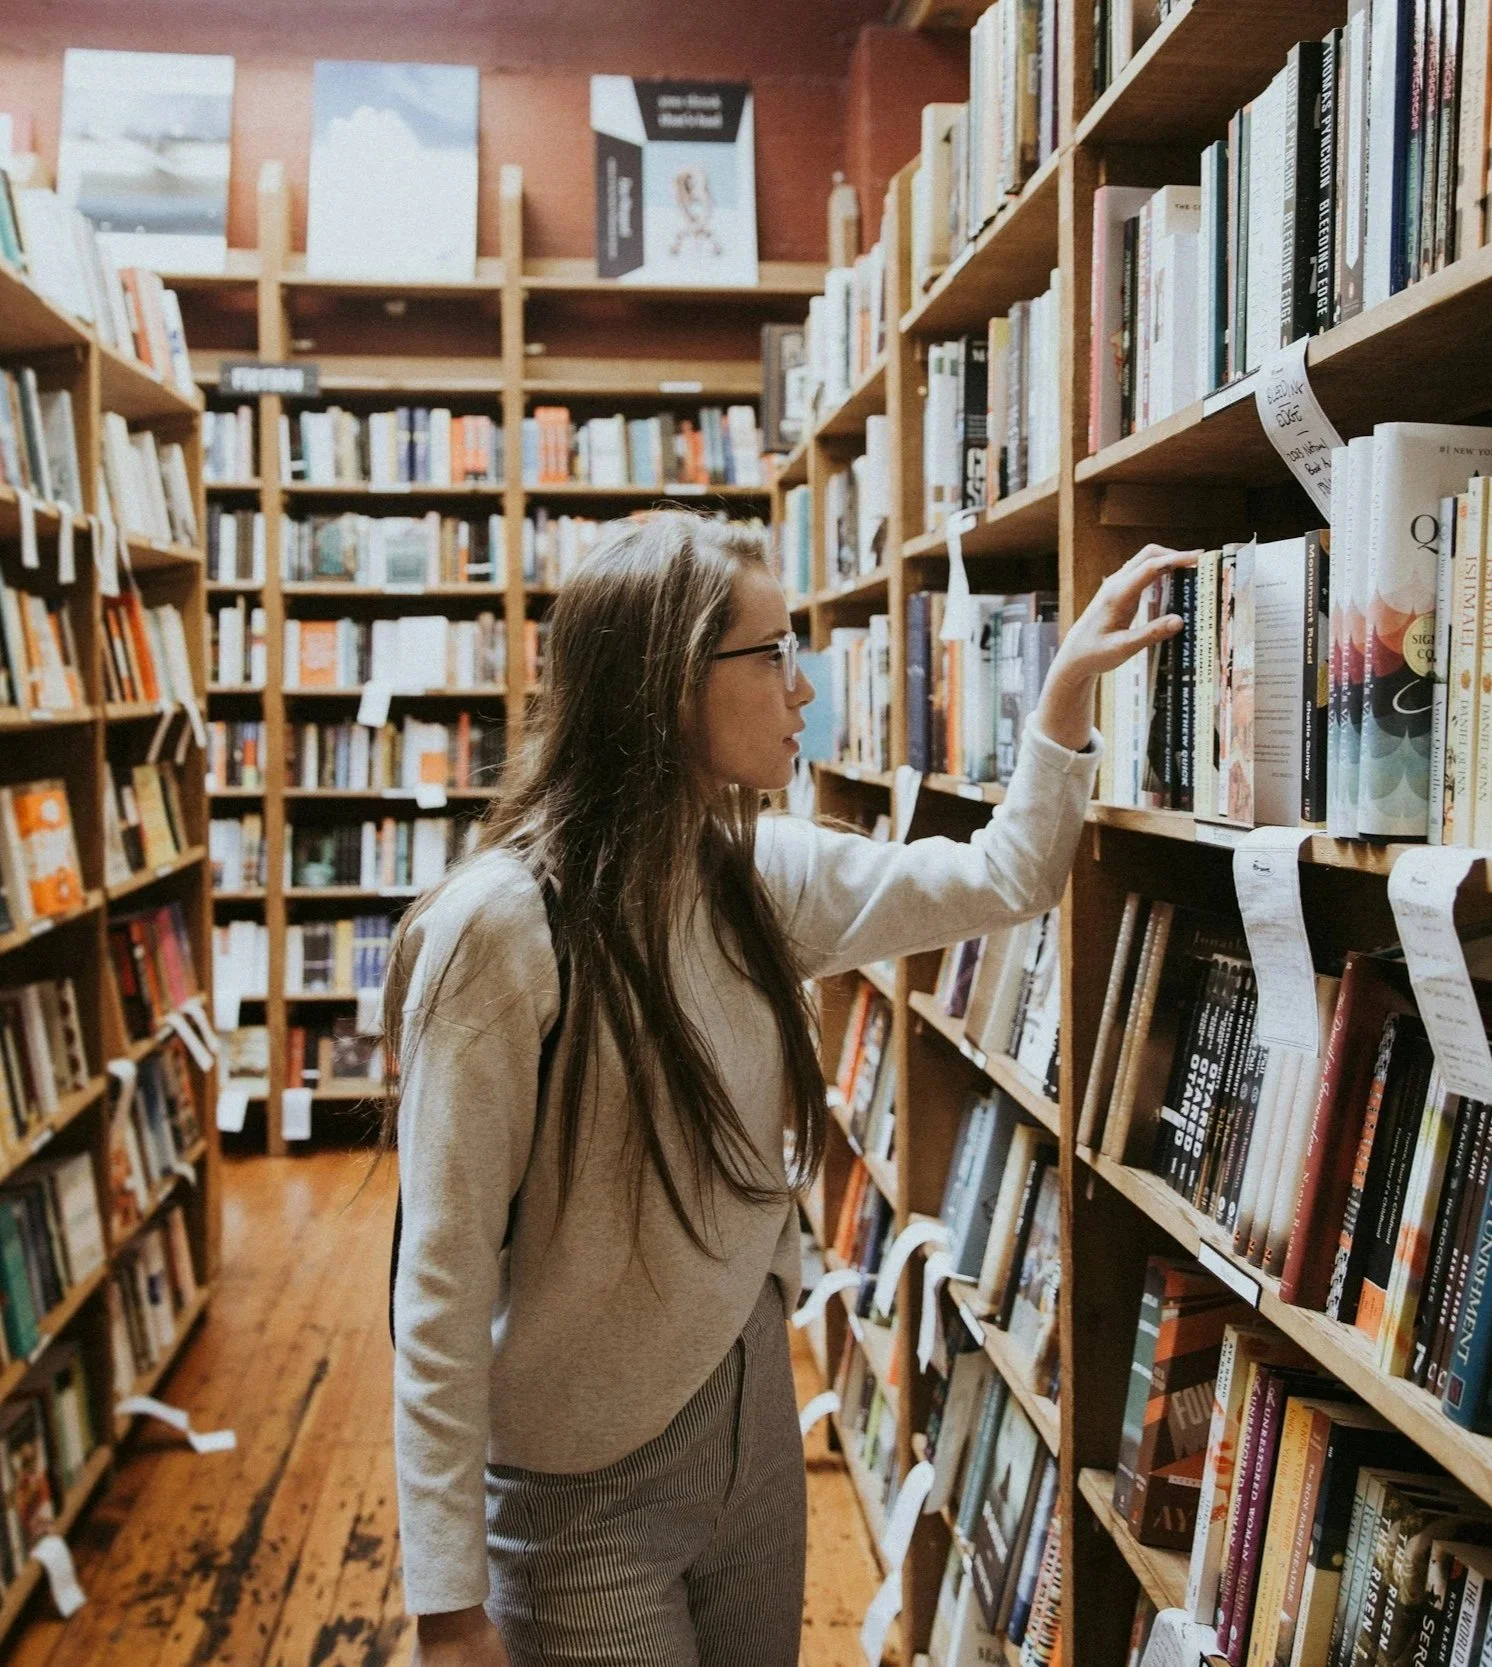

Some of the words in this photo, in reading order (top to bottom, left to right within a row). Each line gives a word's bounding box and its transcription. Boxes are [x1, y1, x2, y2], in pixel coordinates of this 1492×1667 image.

[1286, 61, 1298, 125] THOMAS
[1321, 46, 1333, 113] THOMAS
[1284, 129, 1297, 200] PYNCHON
[1320, 114, 1332, 189] PYNCHON
[1282, 211, 1294, 285] BLEEDING
[1318, 198, 1330, 274] BLEEDING
[1281, 289, 1292, 327] EDGE
[1317, 277, 1329, 317] EDGE
[1276, 405, 1303, 428] EDGE
[1453, 447, 1474, 455] NEW
[1478, 448, 1492, 456] YO
[1307, 544, 1316, 623] Monument
[1461, 556, 1478, 654] ISHMAEL
[1182, 642, 1190, 669] FAIL
[1306, 627, 1314, 665] Road
[1364, 623, 1374, 695] MILLER'S
[1417, 648, 1434, 660] CO
[1341, 633, 1351, 703] MILLER'S
[1181, 687, 1189, 746] MATTHEW
[1304, 700, 1312, 738] Charlie
[1434, 701, 1443, 733] Anna
[1459, 699, 1468, 745] DANIEL
[1480, 704, 1490, 750] DANIEL
[1180, 749, 1188, 787] QUICK
[1432, 739, 1441, 803] Quindlen
[1457, 751, 1466, 795] QUINN
[1479, 757, 1489, 801] QUINN
[1337, 992, 1346, 1011] The
[1214, 1013, 1234, 1090] IMPERFECTIONISTS
[1224, 1015, 1244, 1093] IMPERFECTIONISTS
[1232, 1018, 1251, 1097] IMPERFECTIONISTS
[1328, 1015, 1343, 1063] Devil
[1324, 1060, 1332, 1075] in
[1183, 1058, 1209, 1152] OTARED
[1192, 1063, 1218, 1158] OTARED
[1234, 1106, 1243, 1130] Tom
[1307, 1078, 1329, 1157] Jerusalem
[1477, 1111, 1486, 1137] WHY
[1224, 1132, 1238, 1184] Rachman
[1235, 1137, 1249, 1188] Rachman
[1455, 1123, 1468, 1167] RAKHA
[1468, 1150, 1479, 1180] CAME
[1387, 1180, 1392, 1190] of
[1388, 1158, 1396, 1179] Story
[1395, 1184, 1400, 1195] of
[1397, 1163, 1406, 1184] Story
[1478, 1155, 1490, 1186] CAME
[1376, 1196, 1388, 1239] Childhood
[1385, 1202, 1397, 1245] Childhood
[1445, 1198, 1453, 1216] the
[1428, 1219, 1450, 1303] CROCODILES
[1448, 1247, 1459, 1280] MARY
[1457, 1197, 1492, 1367] UNISHMENT
[1458, 1253, 1470, 1288] MARY
[1226, 1342, 1234, 1365] AYN
[1222, 1368, 1231, 1398] RAND
[1238, 1396, 1257, 1487] UNRESTORED
[1285, 1407, 1297, 1439] KNOW
[1299, 1421, 1309, 1454] KNOW
[1251, 1408, 1272, 1501] UNRESTORED
[1279, 1447, 1291, 1480] YOUR
[1303, 1482, 1312, 1509] RON
[1230, 1493, 1244, 1547] WOMAN
[1242, 1507, 1256, 1561] WOMAN
[1297, 1513, 1307, 1547] RASH
[1376, 1516, 1392, 1555] THE
[1391, 1532, 1408, 1571] THE
[1222, 1555, 1235, 1602] SHOBHA
[1236, 1568, 1249, 1619] SHOBHA
[1287, 1551, 1301, 1602] READER
[1465, 1579, 1479, 1609] THE
[1362, 1566, 1382, 1633] RISEN
[1379, 1583, 1398, 1651] RISEN
[1447, 1591, 1457, 1621] RON
[1340, 1628, 1349, 1658] ABOVE
[1438, 1625, 1451, 1663] RASH
[1454, 1609, 1474, 1665] WORLD
